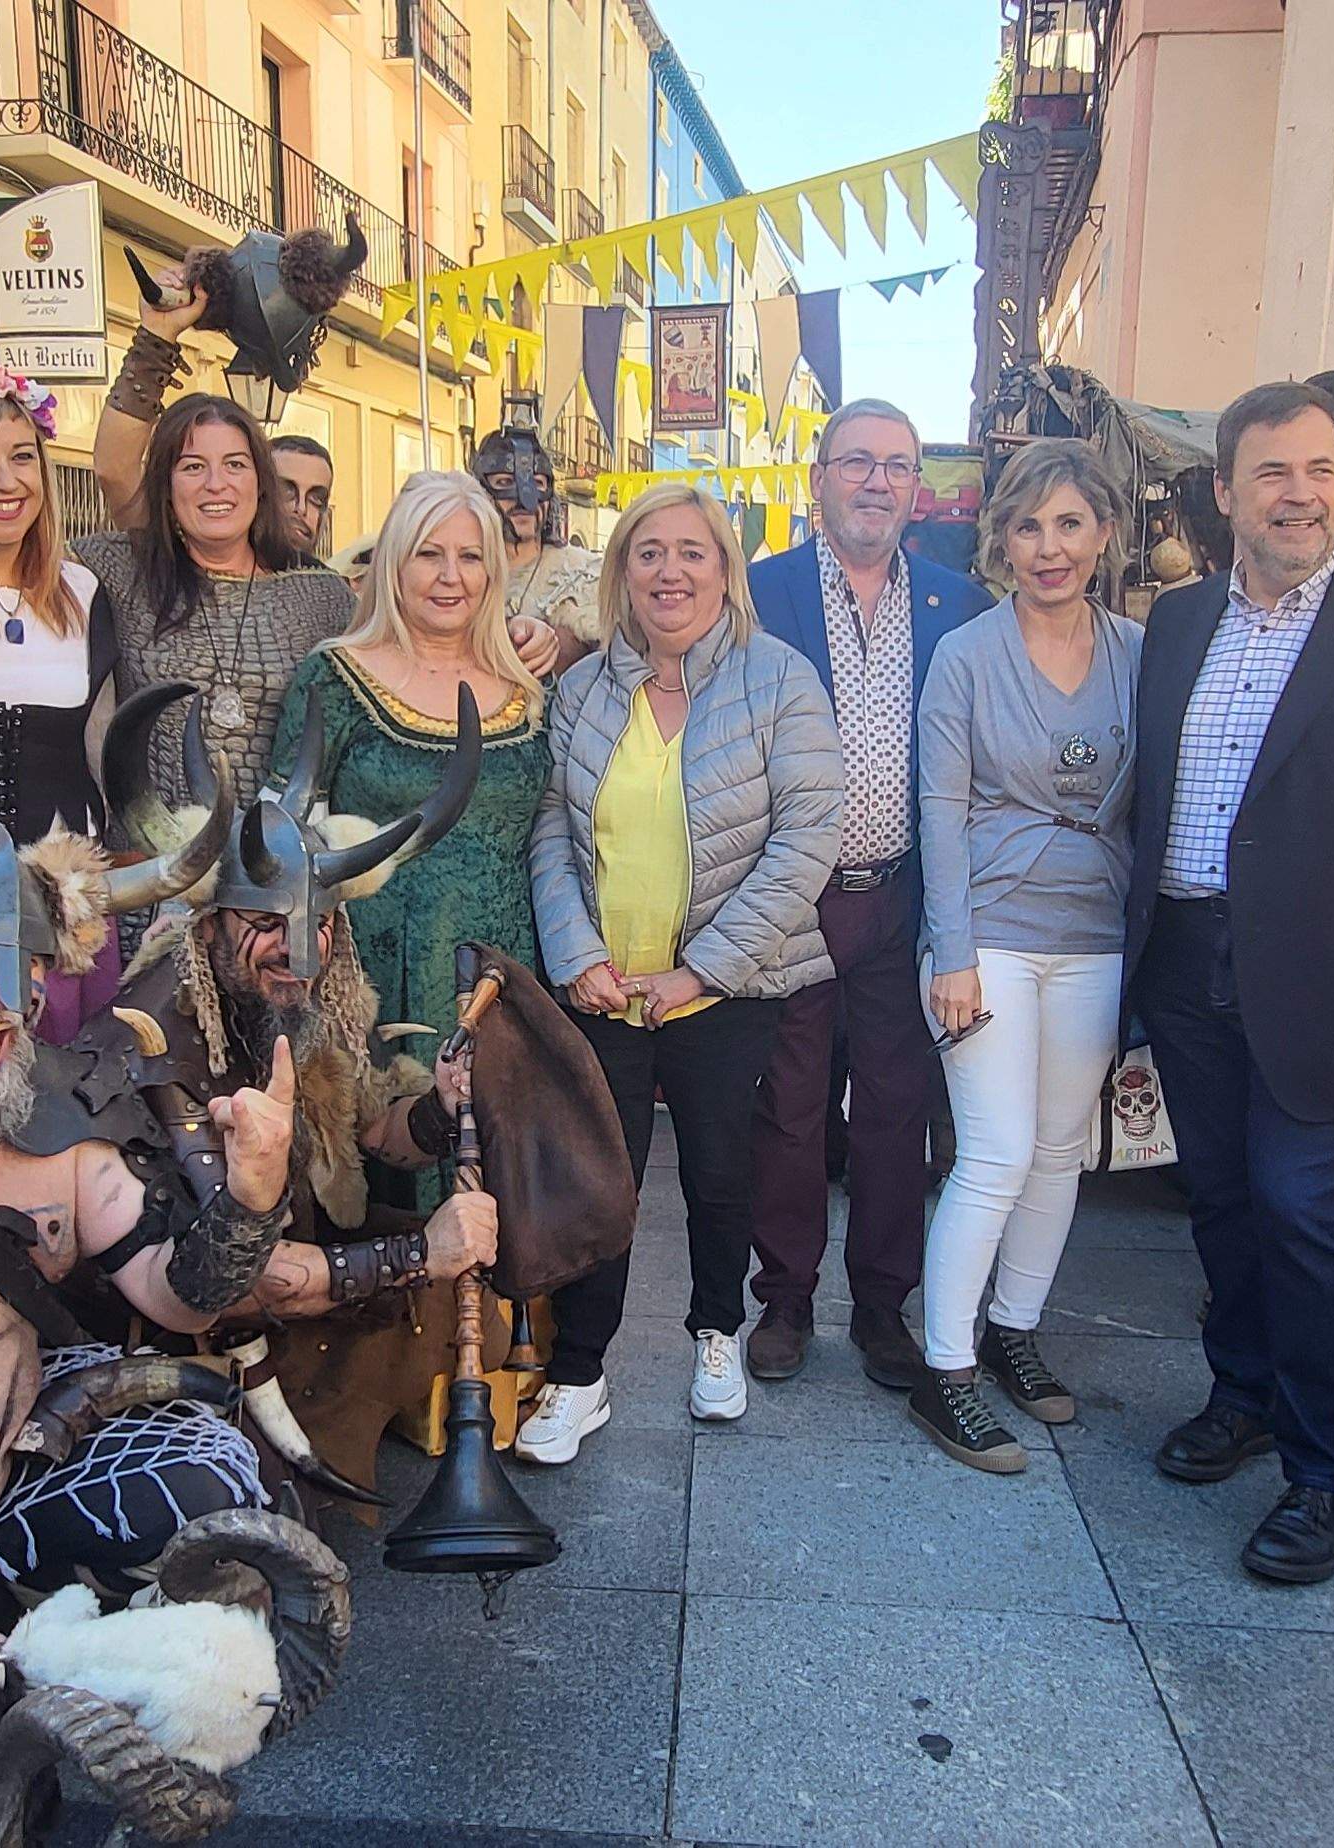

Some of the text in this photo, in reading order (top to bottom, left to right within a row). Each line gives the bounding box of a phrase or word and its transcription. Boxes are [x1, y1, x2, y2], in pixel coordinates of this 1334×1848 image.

[2, 269, 85, 291] VELTINS
[4, 347, 29, 368] Alt
[1112, 1140, 1173, 1161] ARTINA
